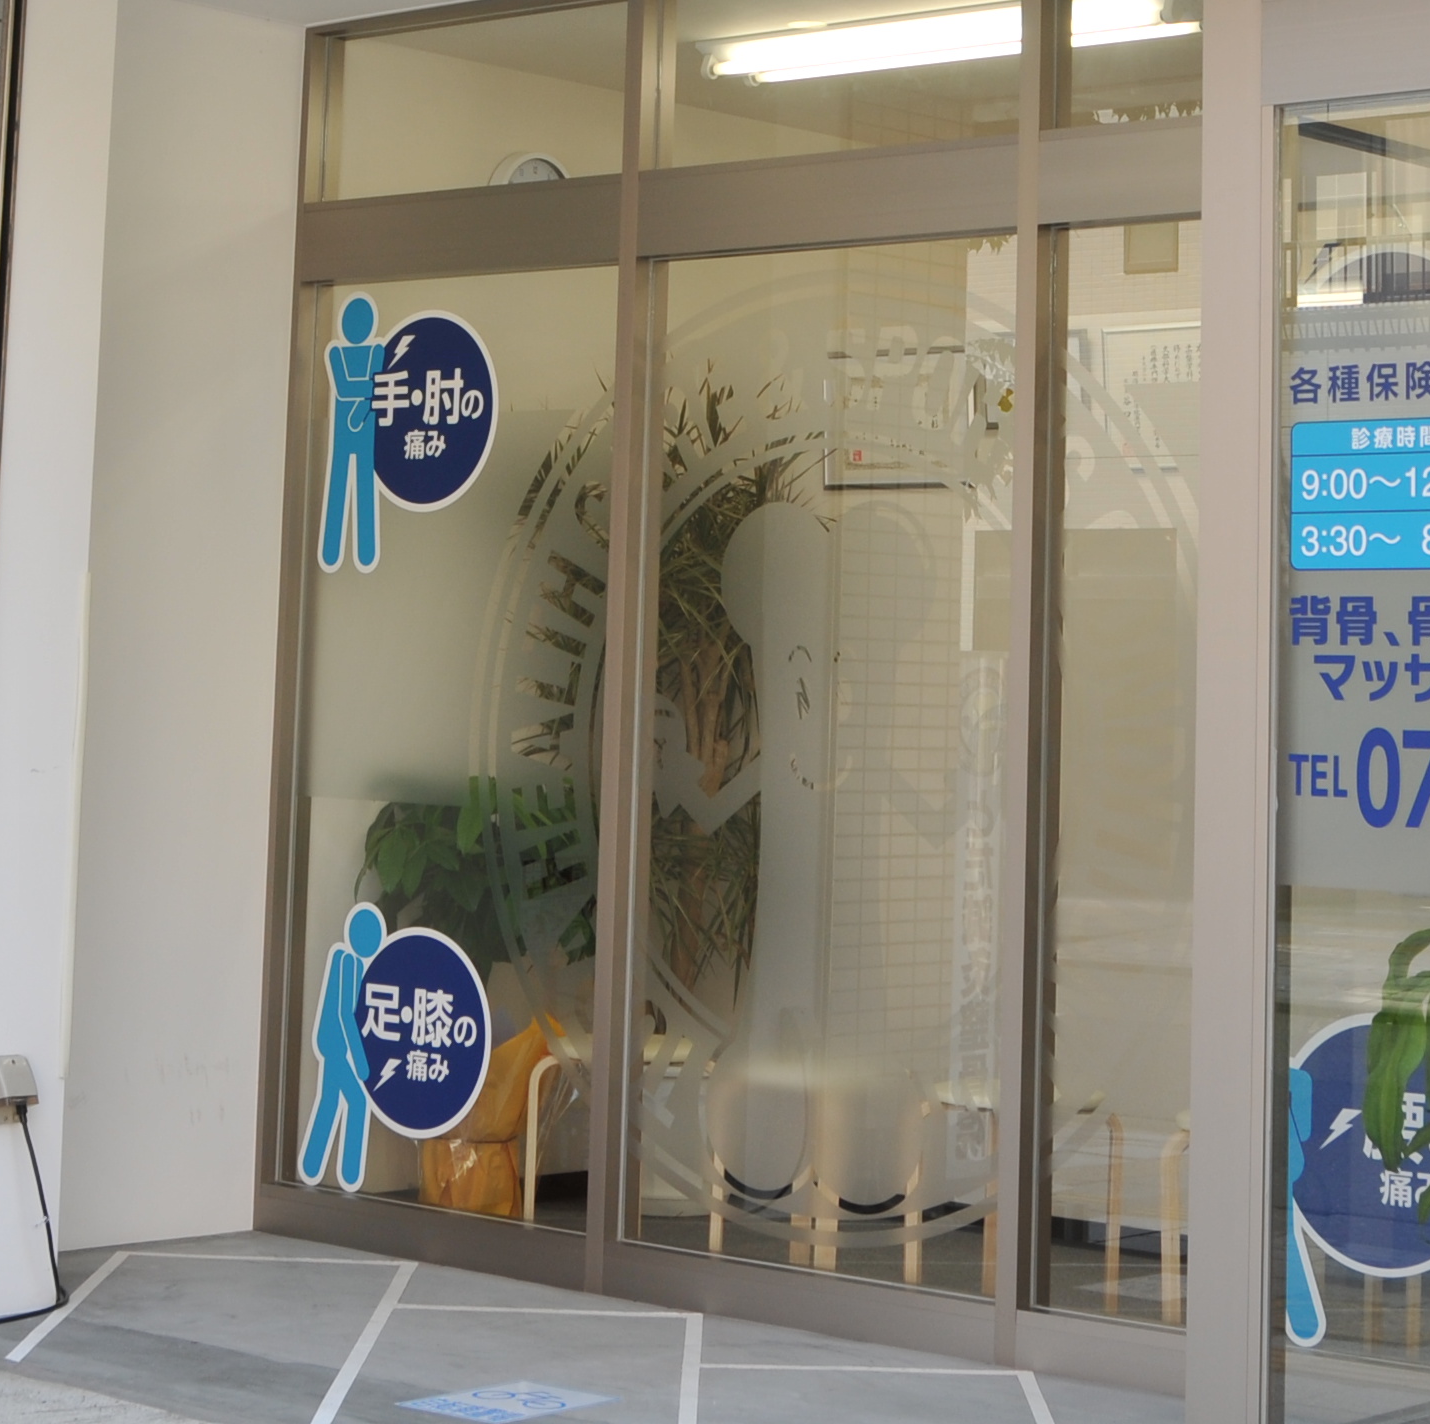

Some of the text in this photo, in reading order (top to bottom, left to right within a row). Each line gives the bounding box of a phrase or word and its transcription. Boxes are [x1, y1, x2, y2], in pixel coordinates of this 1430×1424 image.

[371, 368, 484, 426] 手・肘の
[404, 430, 447, 459] 痛み
[1288, 753, 1348, 799] TEL
[361, 983, 477, 1048] 足・膝の
[406, 1050, 449, 1082] 痛み
